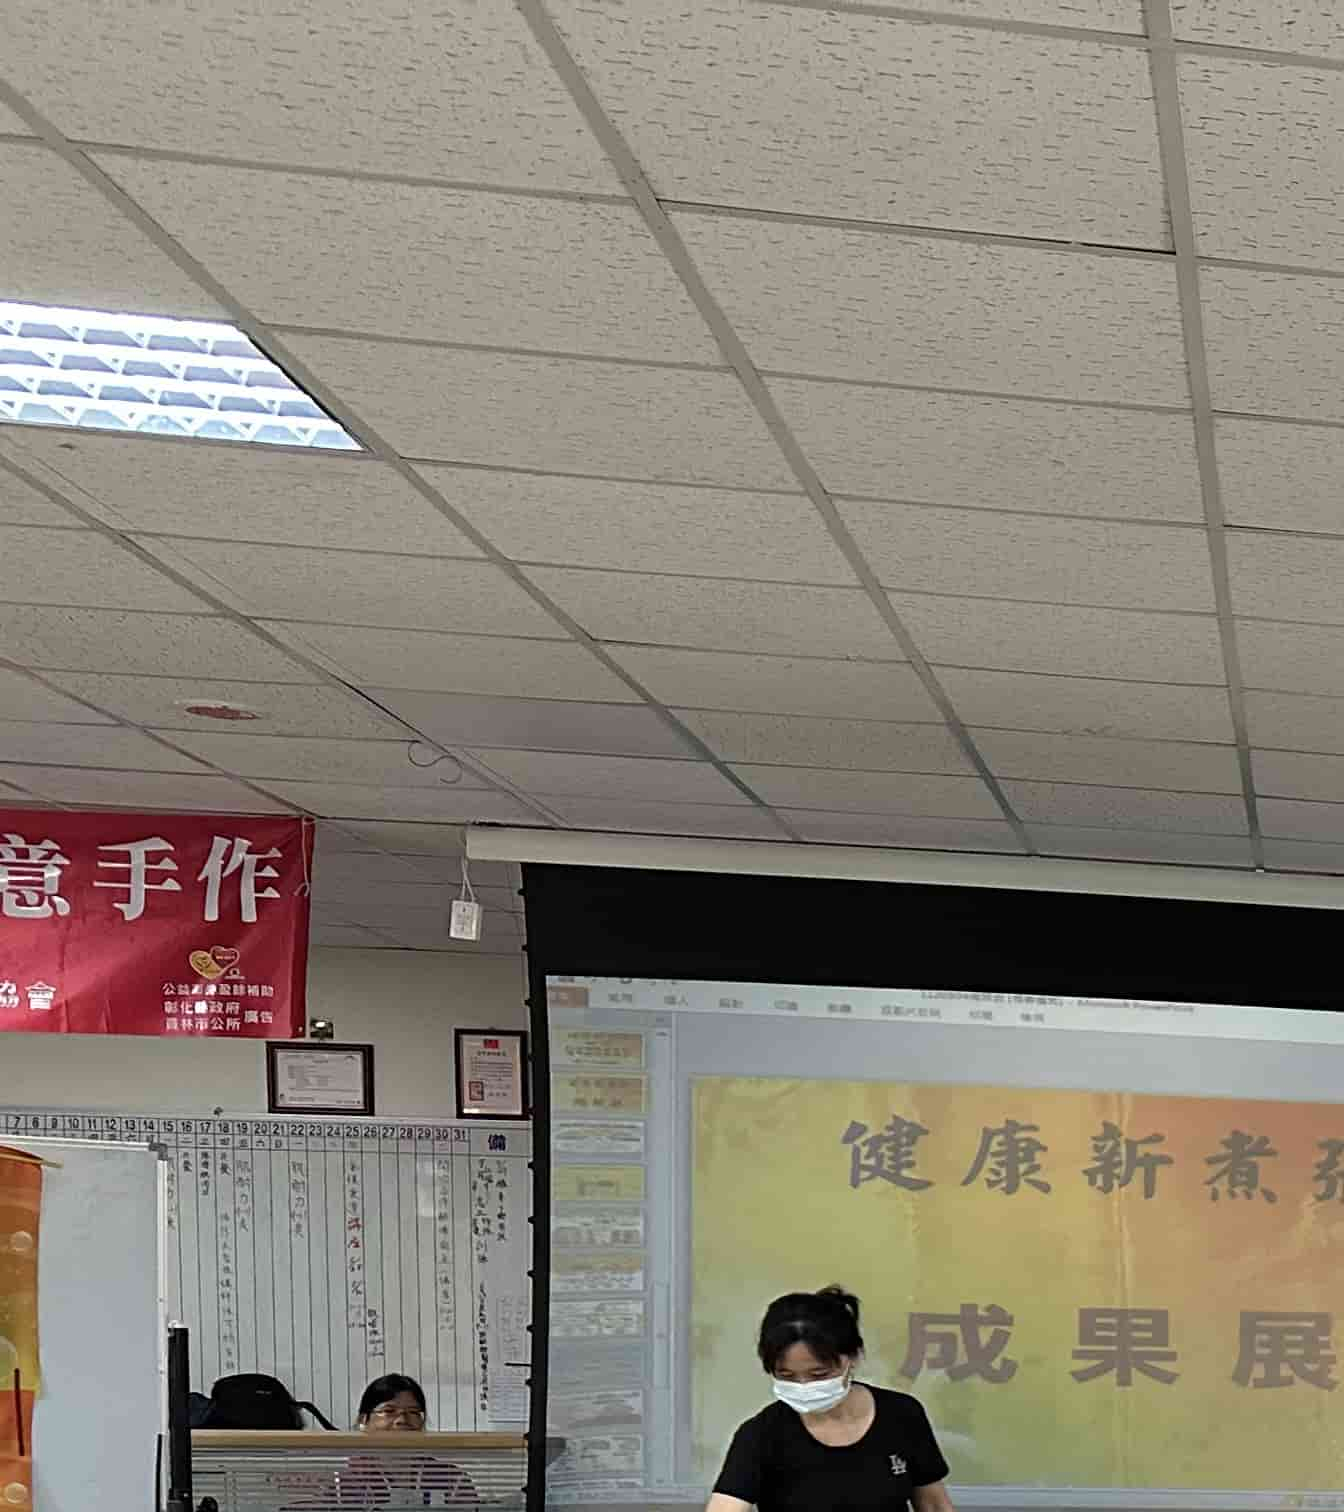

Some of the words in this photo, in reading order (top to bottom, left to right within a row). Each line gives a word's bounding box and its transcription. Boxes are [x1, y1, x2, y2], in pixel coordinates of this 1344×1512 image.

[0, 833, 283, 922] 意手作
[14, 1116, 21, 1129] 7
[68, 1118, 79, 1129] 10
[88, 1118, 97, 1129] 11
[105, 1118, 117, 1130] 12
[125, 1119, 136, 1130] 13
[143, 1120, 154, 1131] 14
[163, 1120, 174, 1132] 15
[181, 1121, 192, 1132] 16
[200, 1122, 211, 1132] 17
[218, 1122, 230, 1133] 18
[237, 1123, 248, 1134] 19
[254, 1123, 267, 1135] 20
[272, 1124, 285, 1135] 21
[290, 1124, 305, 1136] 22
[309, 1125, 322, 1136] 23
[327, 1125, 340, 1137] 24
[345, 1126, 360, 1137] 25
[364, 1127, 377, 1137] 26
[382, 1127, 395, 1137] 27
[400, 1127, 413, 1138] 28
[418, 1128, 431, 1138] 29
[436, 1128, 449, 1139] 30
[454, 1129, 466, 1139] 31
[900, 1303, 1341, 1392] 成果展
